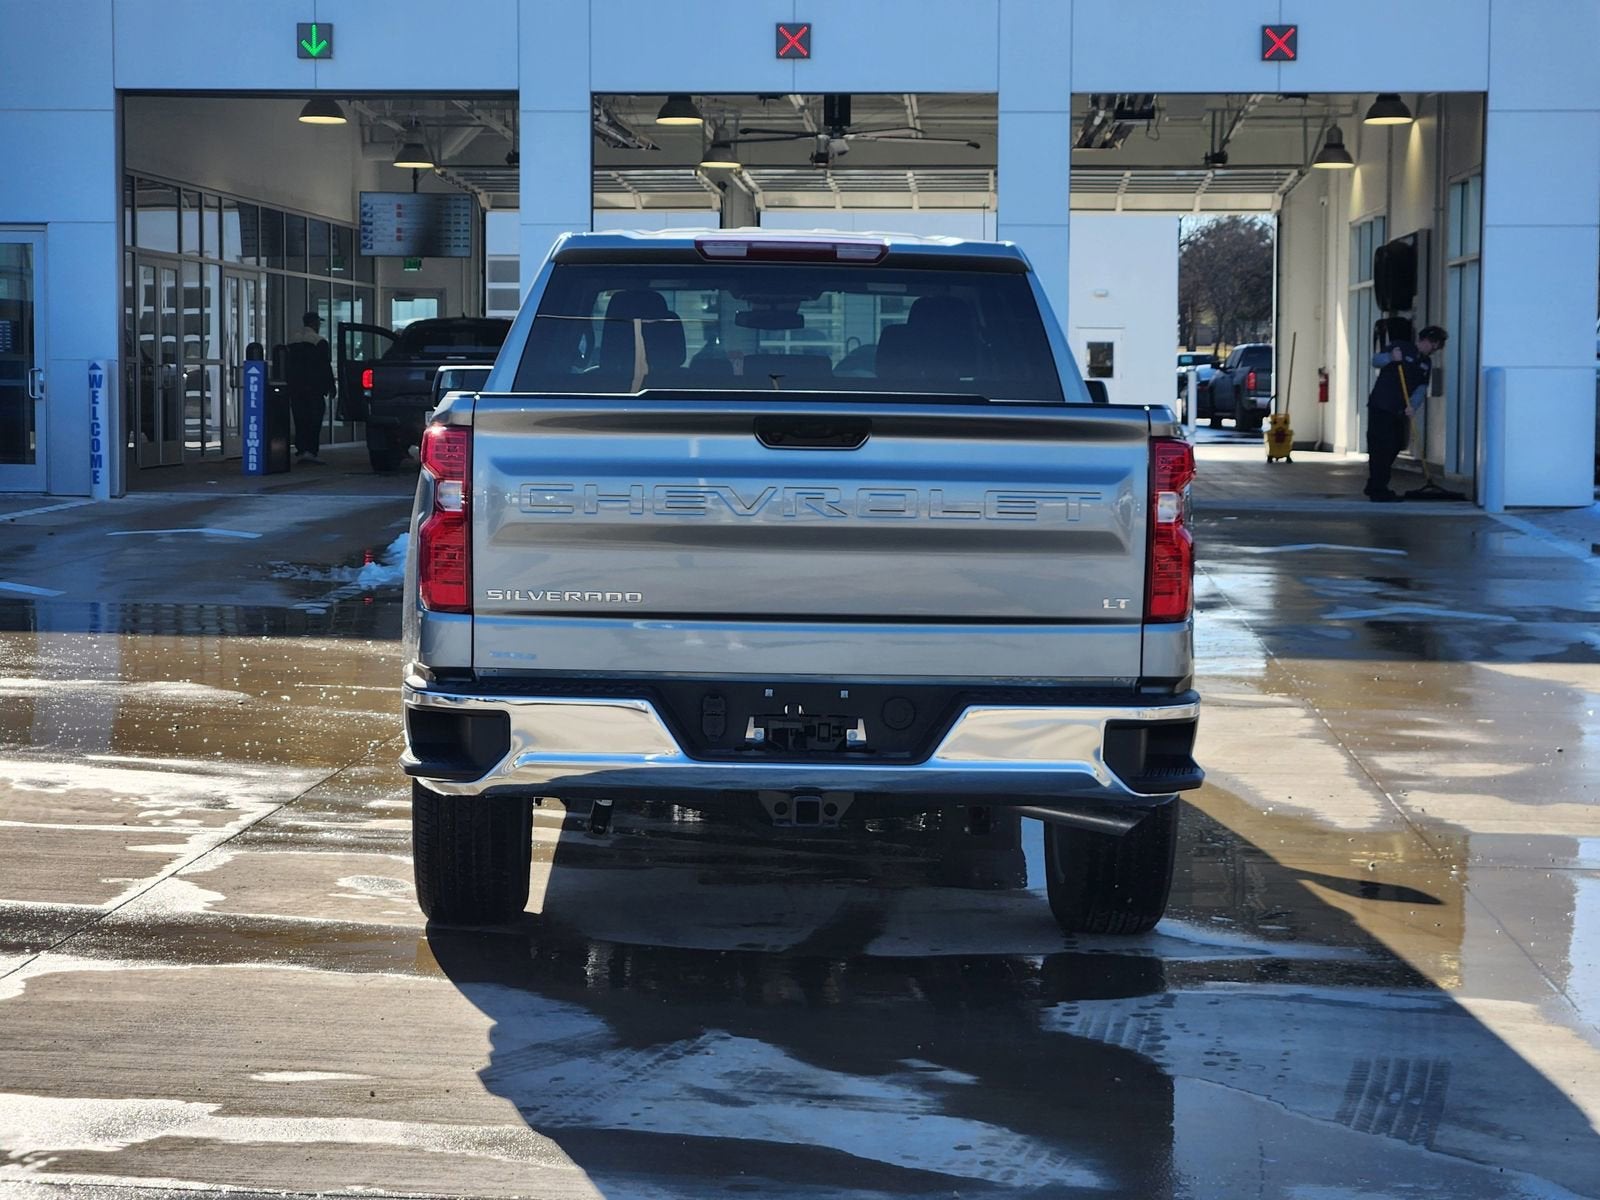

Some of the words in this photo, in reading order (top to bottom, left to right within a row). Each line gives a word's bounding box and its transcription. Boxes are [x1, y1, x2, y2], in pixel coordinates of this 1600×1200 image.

[249, 376, 258, 408] PULL
[88, 374, 103, 485] WELCOME
[247, 415, 259, 471] FORWARD
[519, 482, 1102, 522] CHEVROLET
[486, 589, 643, 604] SILVERADO
[1102, 598, 1130, 609] LT
